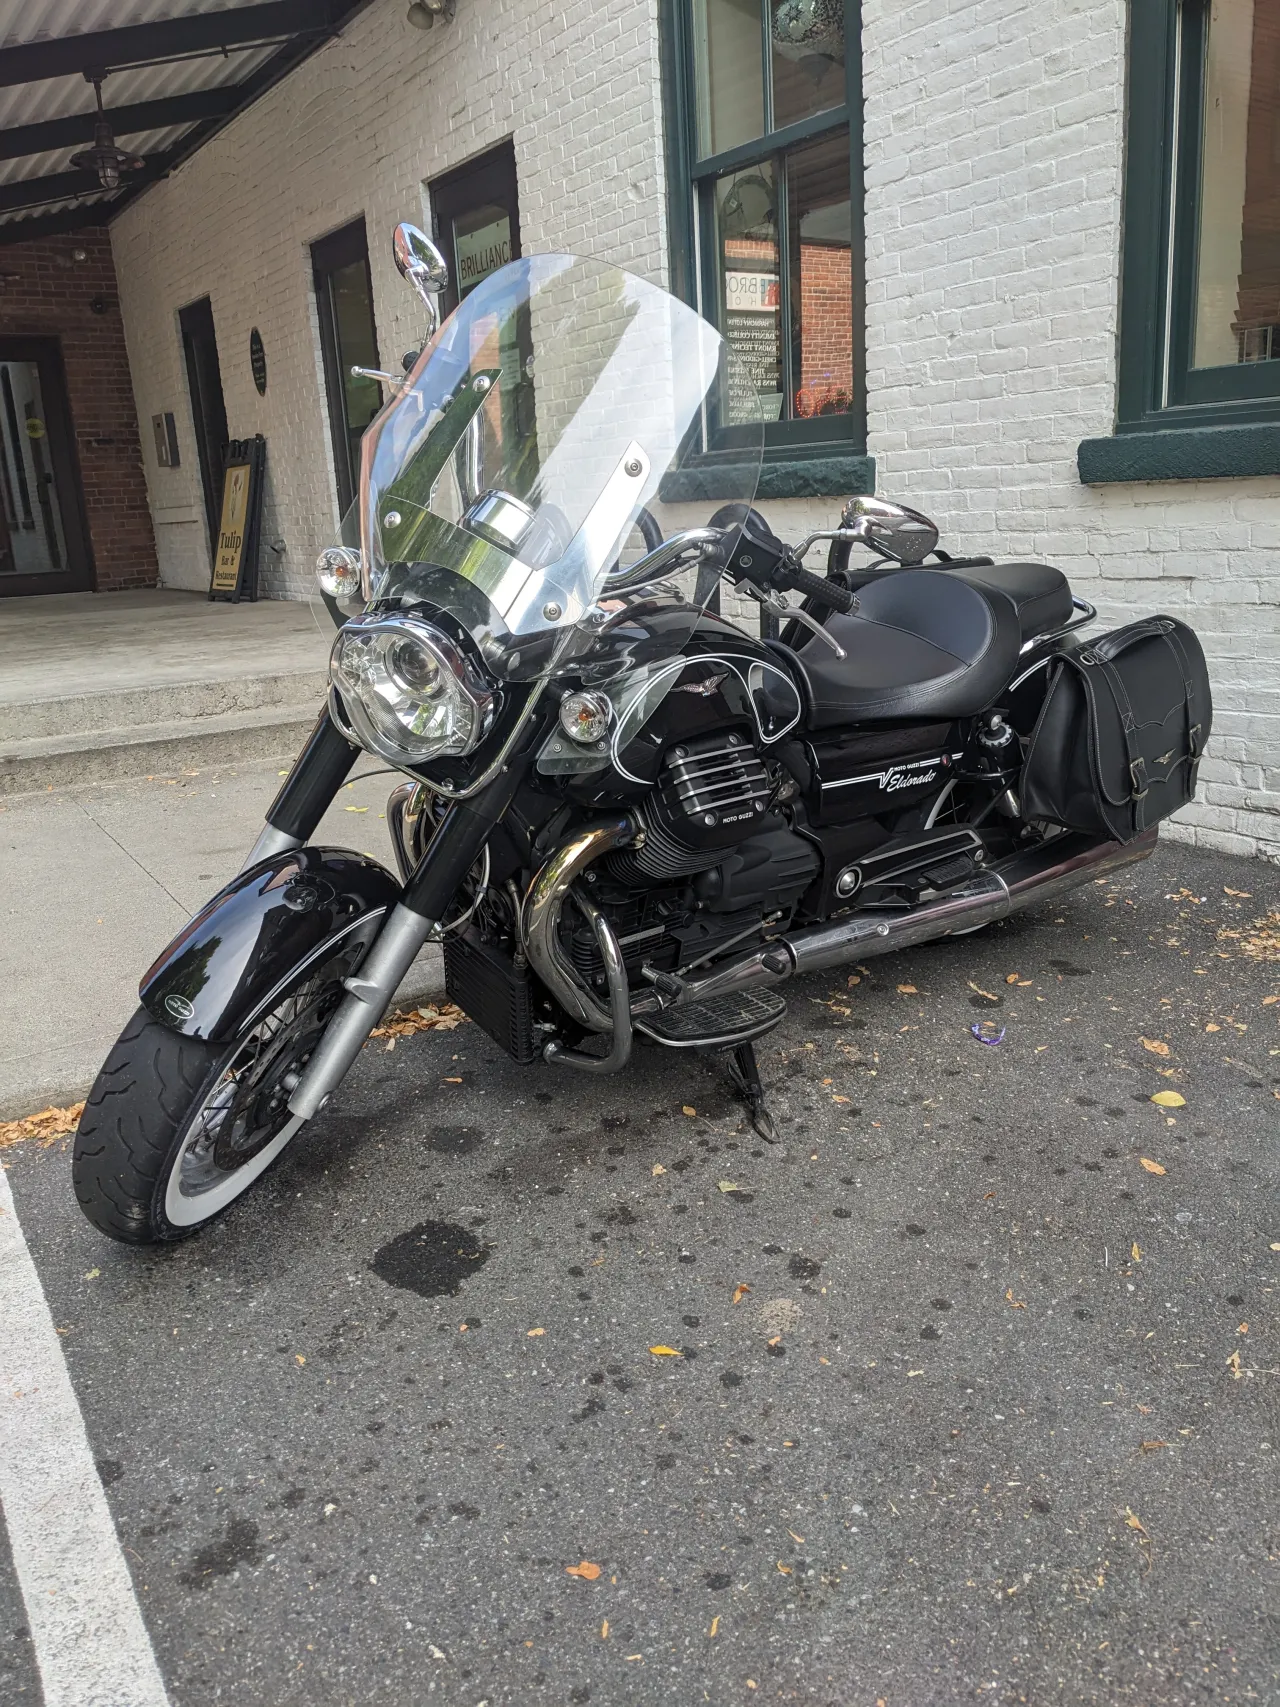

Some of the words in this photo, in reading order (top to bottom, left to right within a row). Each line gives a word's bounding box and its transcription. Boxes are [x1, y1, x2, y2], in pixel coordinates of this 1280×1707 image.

[220, 530, 242, 553] Tulip
[221, 555, 229, 565] Bar
[215, 570, 237, 580] Restaurant
[886, 769, 937, 793] Eldorado
[722, 815, 737, 824] MOTO
[738, 811, 753, 820] GUZZI
